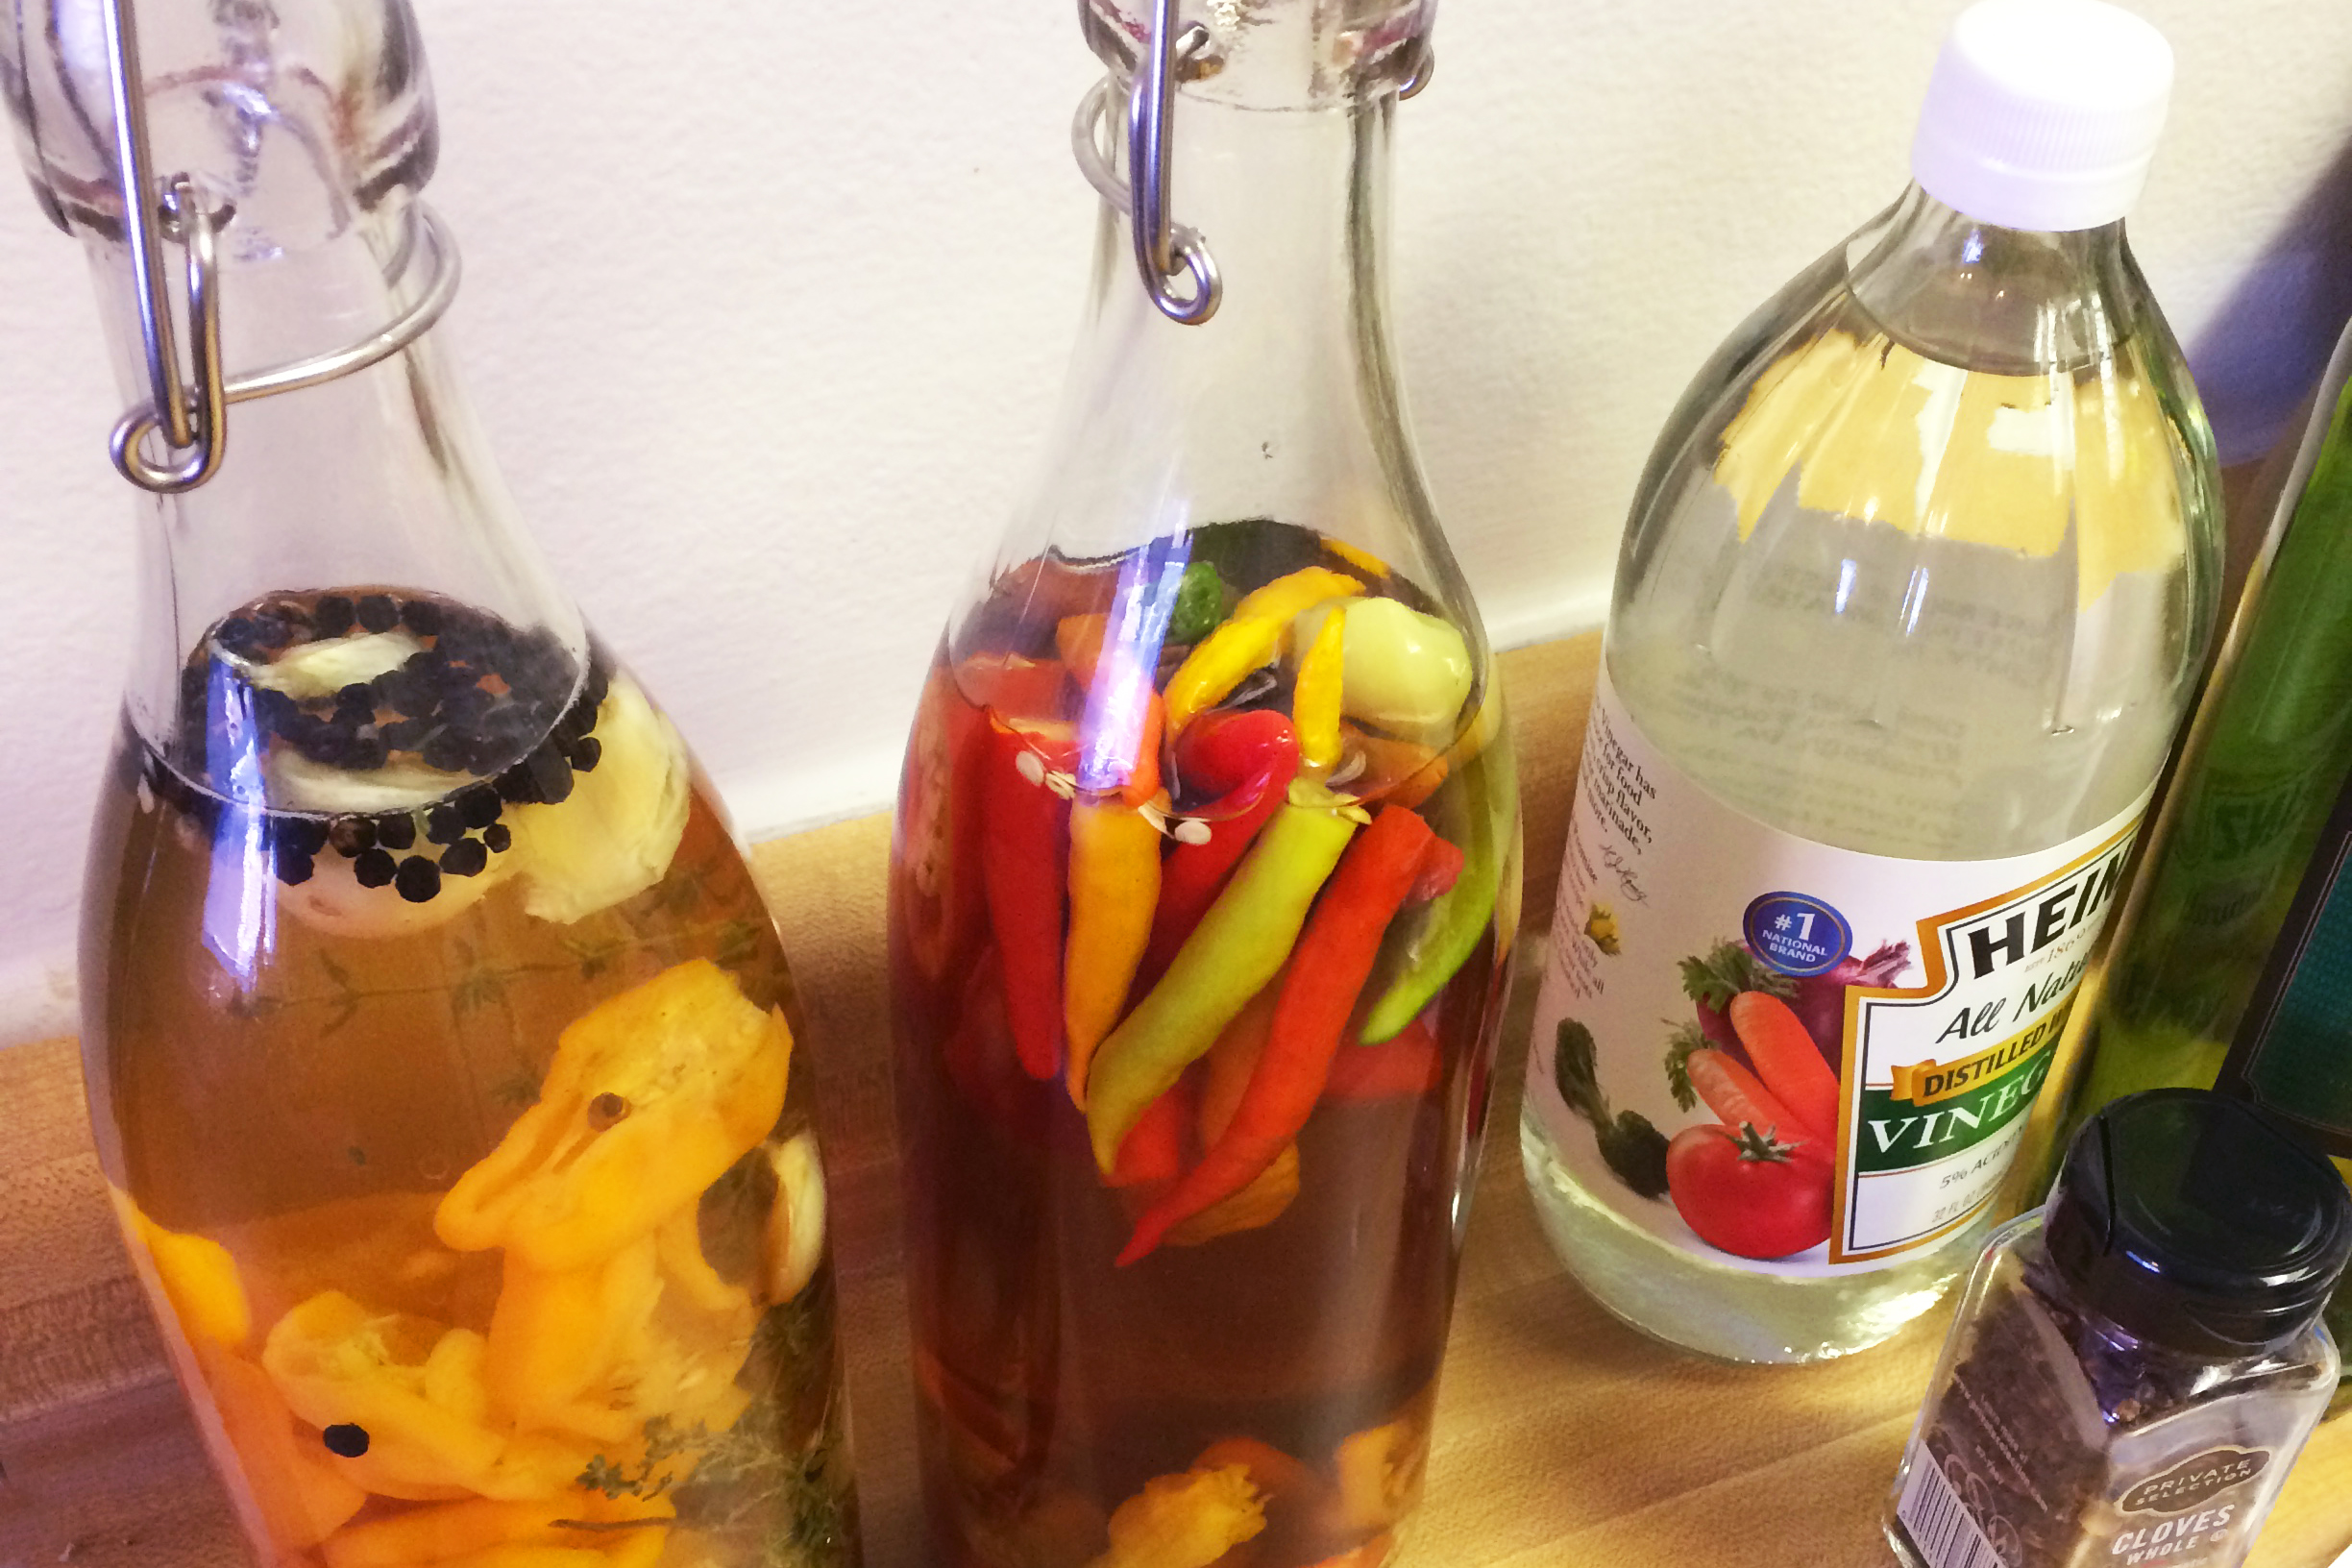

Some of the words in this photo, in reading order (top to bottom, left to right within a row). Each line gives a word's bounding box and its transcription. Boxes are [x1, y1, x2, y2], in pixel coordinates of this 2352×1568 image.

[1603, 743, 1616, 771] for
[1617, 766, 1643, 806] food
[1635, 765, 1657, 799] has
[1616, 790, 1653, 844] flavor,
[1762, 929, 1828, 956] NATIONAL
[1774, 912, 1816, 941] #1
[1769, 942, 1817, 963] BRAND
[1935, 996, 2007, 1044] All
[1923, 1021, 2047, 1097] DISTILLED
[1939, 1168, 1969, 1190] 5%
[2135, 1468, 2252, 1507] SELECTION
[2143, 1458, 2252, 1496] PRIVATE
[2112, 1504, 2236, 1556] CLOVES
[2126, 1535, 2200, 1566] WHOLE
